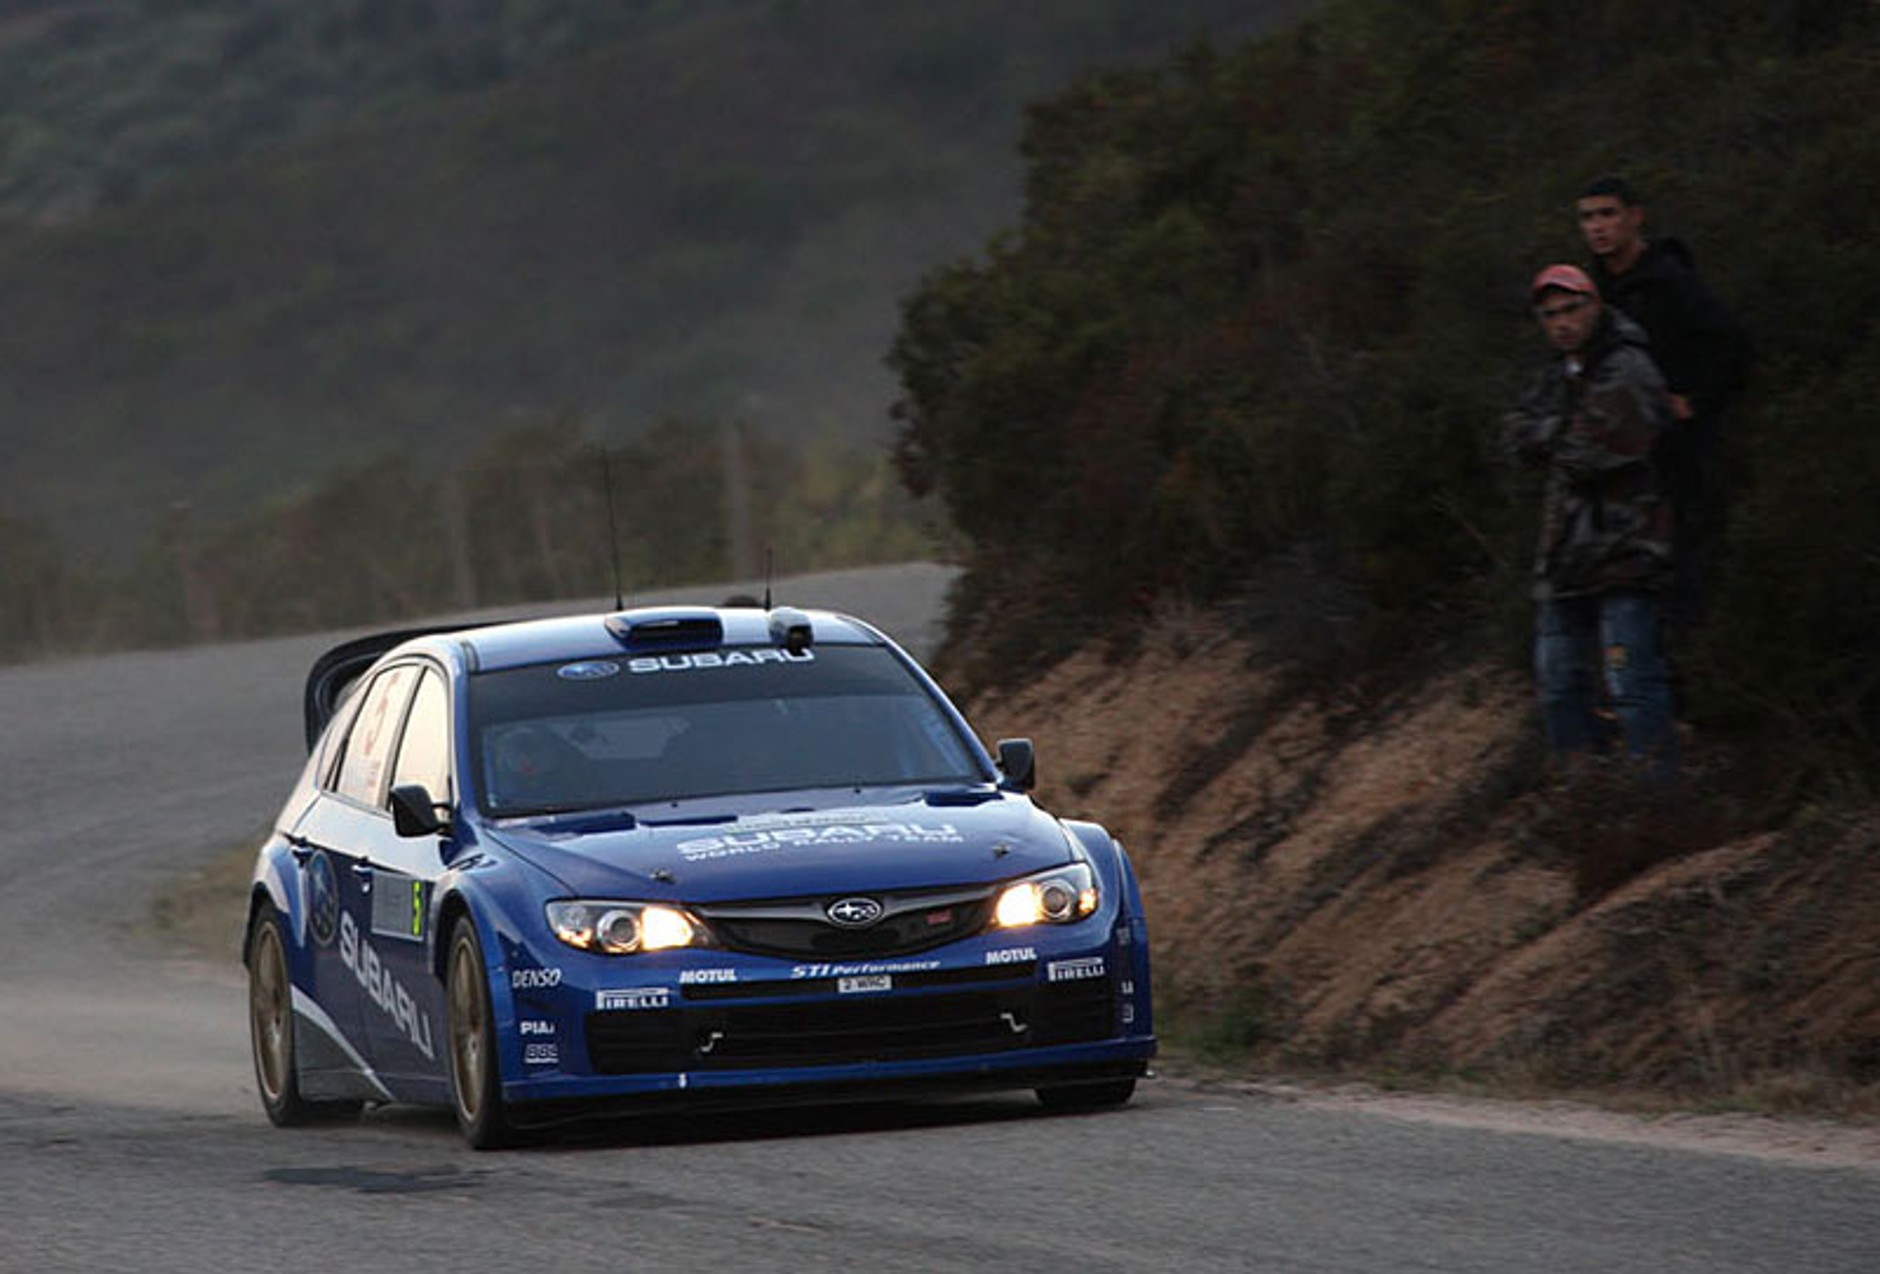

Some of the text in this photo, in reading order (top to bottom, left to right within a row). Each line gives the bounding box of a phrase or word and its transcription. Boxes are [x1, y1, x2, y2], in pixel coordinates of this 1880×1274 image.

[628, 648, 815, 673] SUBARU
[676, 823, 959, 854] SUBARU
[411, 880, 423, 936] 5
[985, 947, 1037, 965] MOTUL
[512, 968, 560, 988] DENSO
[679, 968, 737, 984] MOTUL
[790, 960, 941, 980] STI Performance
[1048, 957, 1105, 982] PIRELLI
[339, 909, 434, 1060] SUBARU
[596, 987, 669, 1010] PIRELLI
